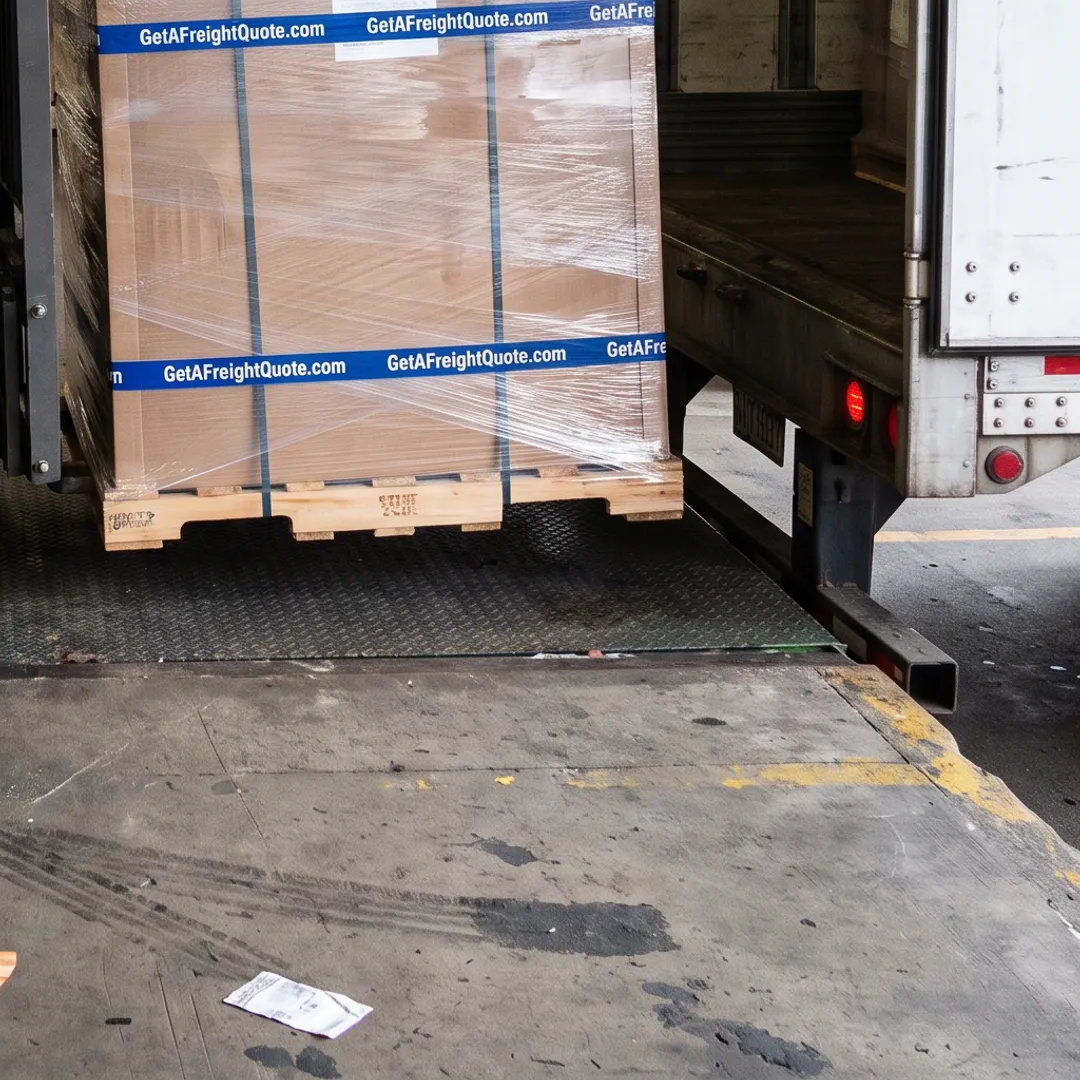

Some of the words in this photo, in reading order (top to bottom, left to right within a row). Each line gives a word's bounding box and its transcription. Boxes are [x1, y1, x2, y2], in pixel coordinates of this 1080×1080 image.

[139, 21, 325, 47] GetAFreightQuote.com
[366, 10, 549, 34] GetAFreightQuote.com
[163, 360, 346, 383] GetAFreightQuote.com
[387, 348, 567, 371] GetAFreightQuote.com
